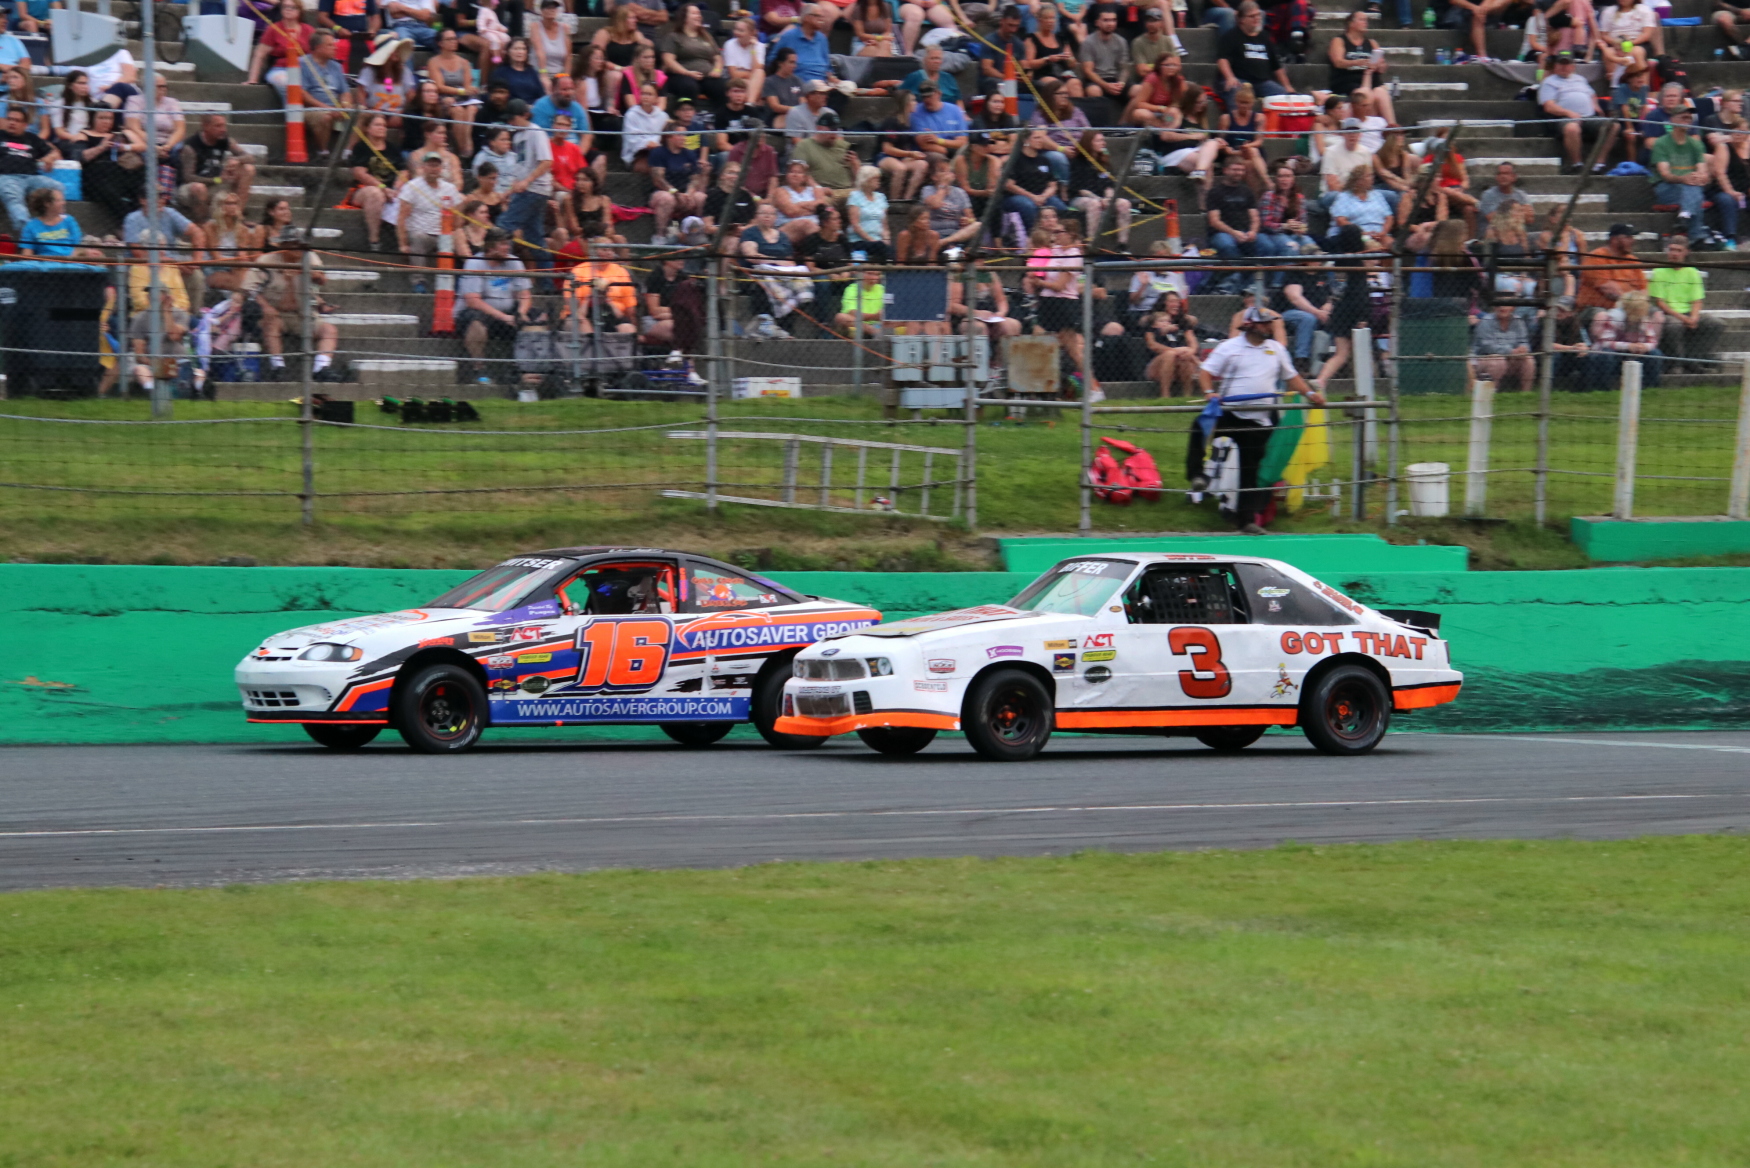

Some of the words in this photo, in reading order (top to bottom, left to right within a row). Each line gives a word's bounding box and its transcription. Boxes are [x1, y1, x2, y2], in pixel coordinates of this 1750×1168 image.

[510, 626, 543, 641] ACT
[692, 625, 808, 648] AUTOSAVER
[1083, 633, 1115, 648] ACT
[578, 618, 672, 688] 16
[1280, 631, 1344, 655] GOT
[1352, 631, 1427, 660] THAT
[1168, 626, 1232, 699] 3
[517, 702, 732, 716] WWW.AUTOSAVERGROUP.COM
